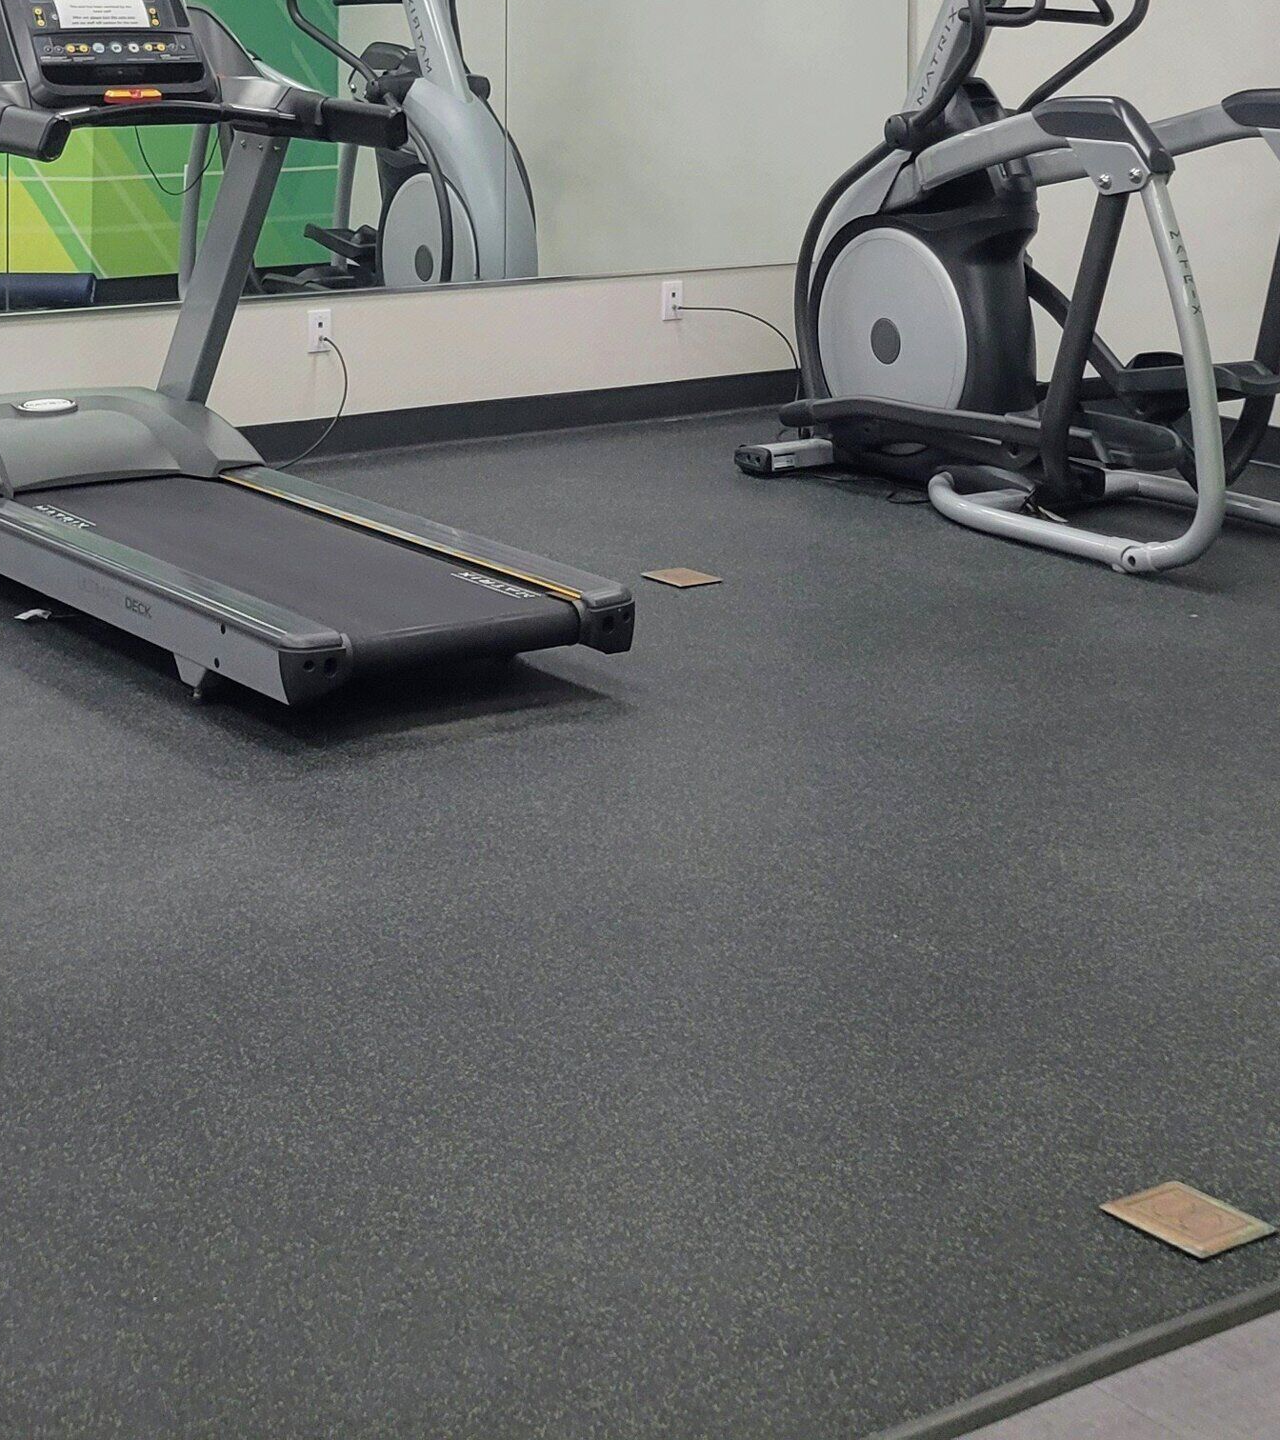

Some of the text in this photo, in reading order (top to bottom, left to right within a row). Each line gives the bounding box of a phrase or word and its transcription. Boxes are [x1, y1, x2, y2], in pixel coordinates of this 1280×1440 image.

[916, 5, 958, 106] MATRIX
[1169, 230, 1203, 315] MATRIX
[32, 504, 91, 530] MATRIX
[124, 596, 153, 620] DECK
